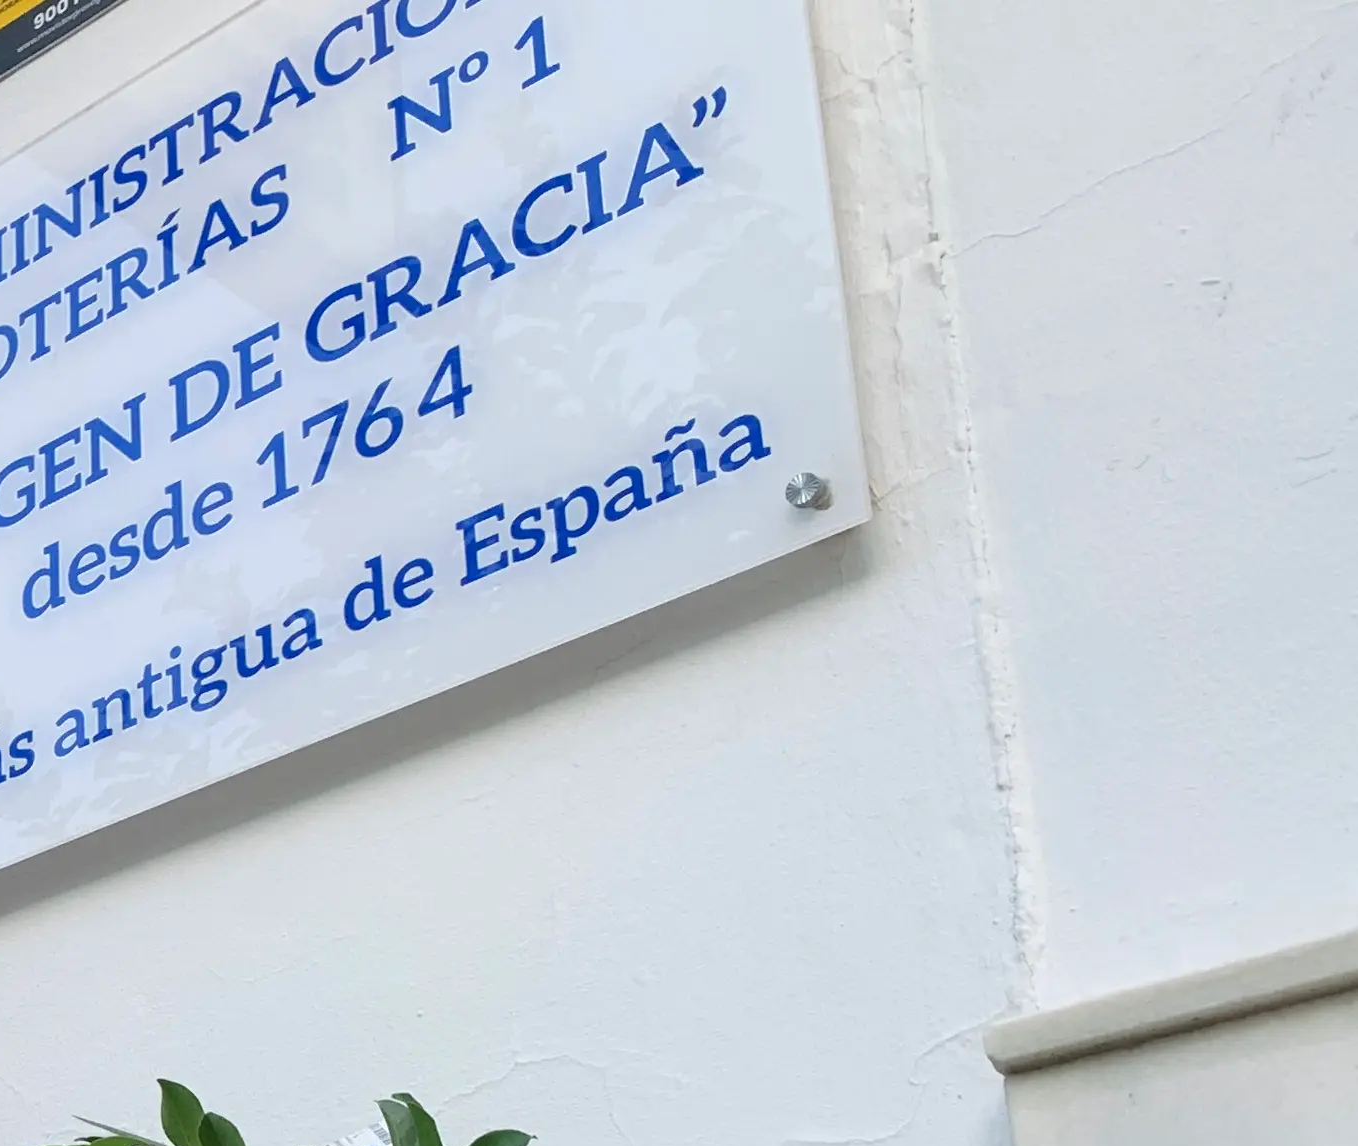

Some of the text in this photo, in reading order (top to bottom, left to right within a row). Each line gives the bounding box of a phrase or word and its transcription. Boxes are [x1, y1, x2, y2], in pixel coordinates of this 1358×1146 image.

[388, 51, 489, 160] Nº
[515, 17, 561, 88] 1
[22, 345, 473, 619] desde 1764
[168, 323, 283, 441] DE
[54, 607, 324, 766] antigua
[343, 555, 434, 632] de
[455, 414, 772, 586] España
